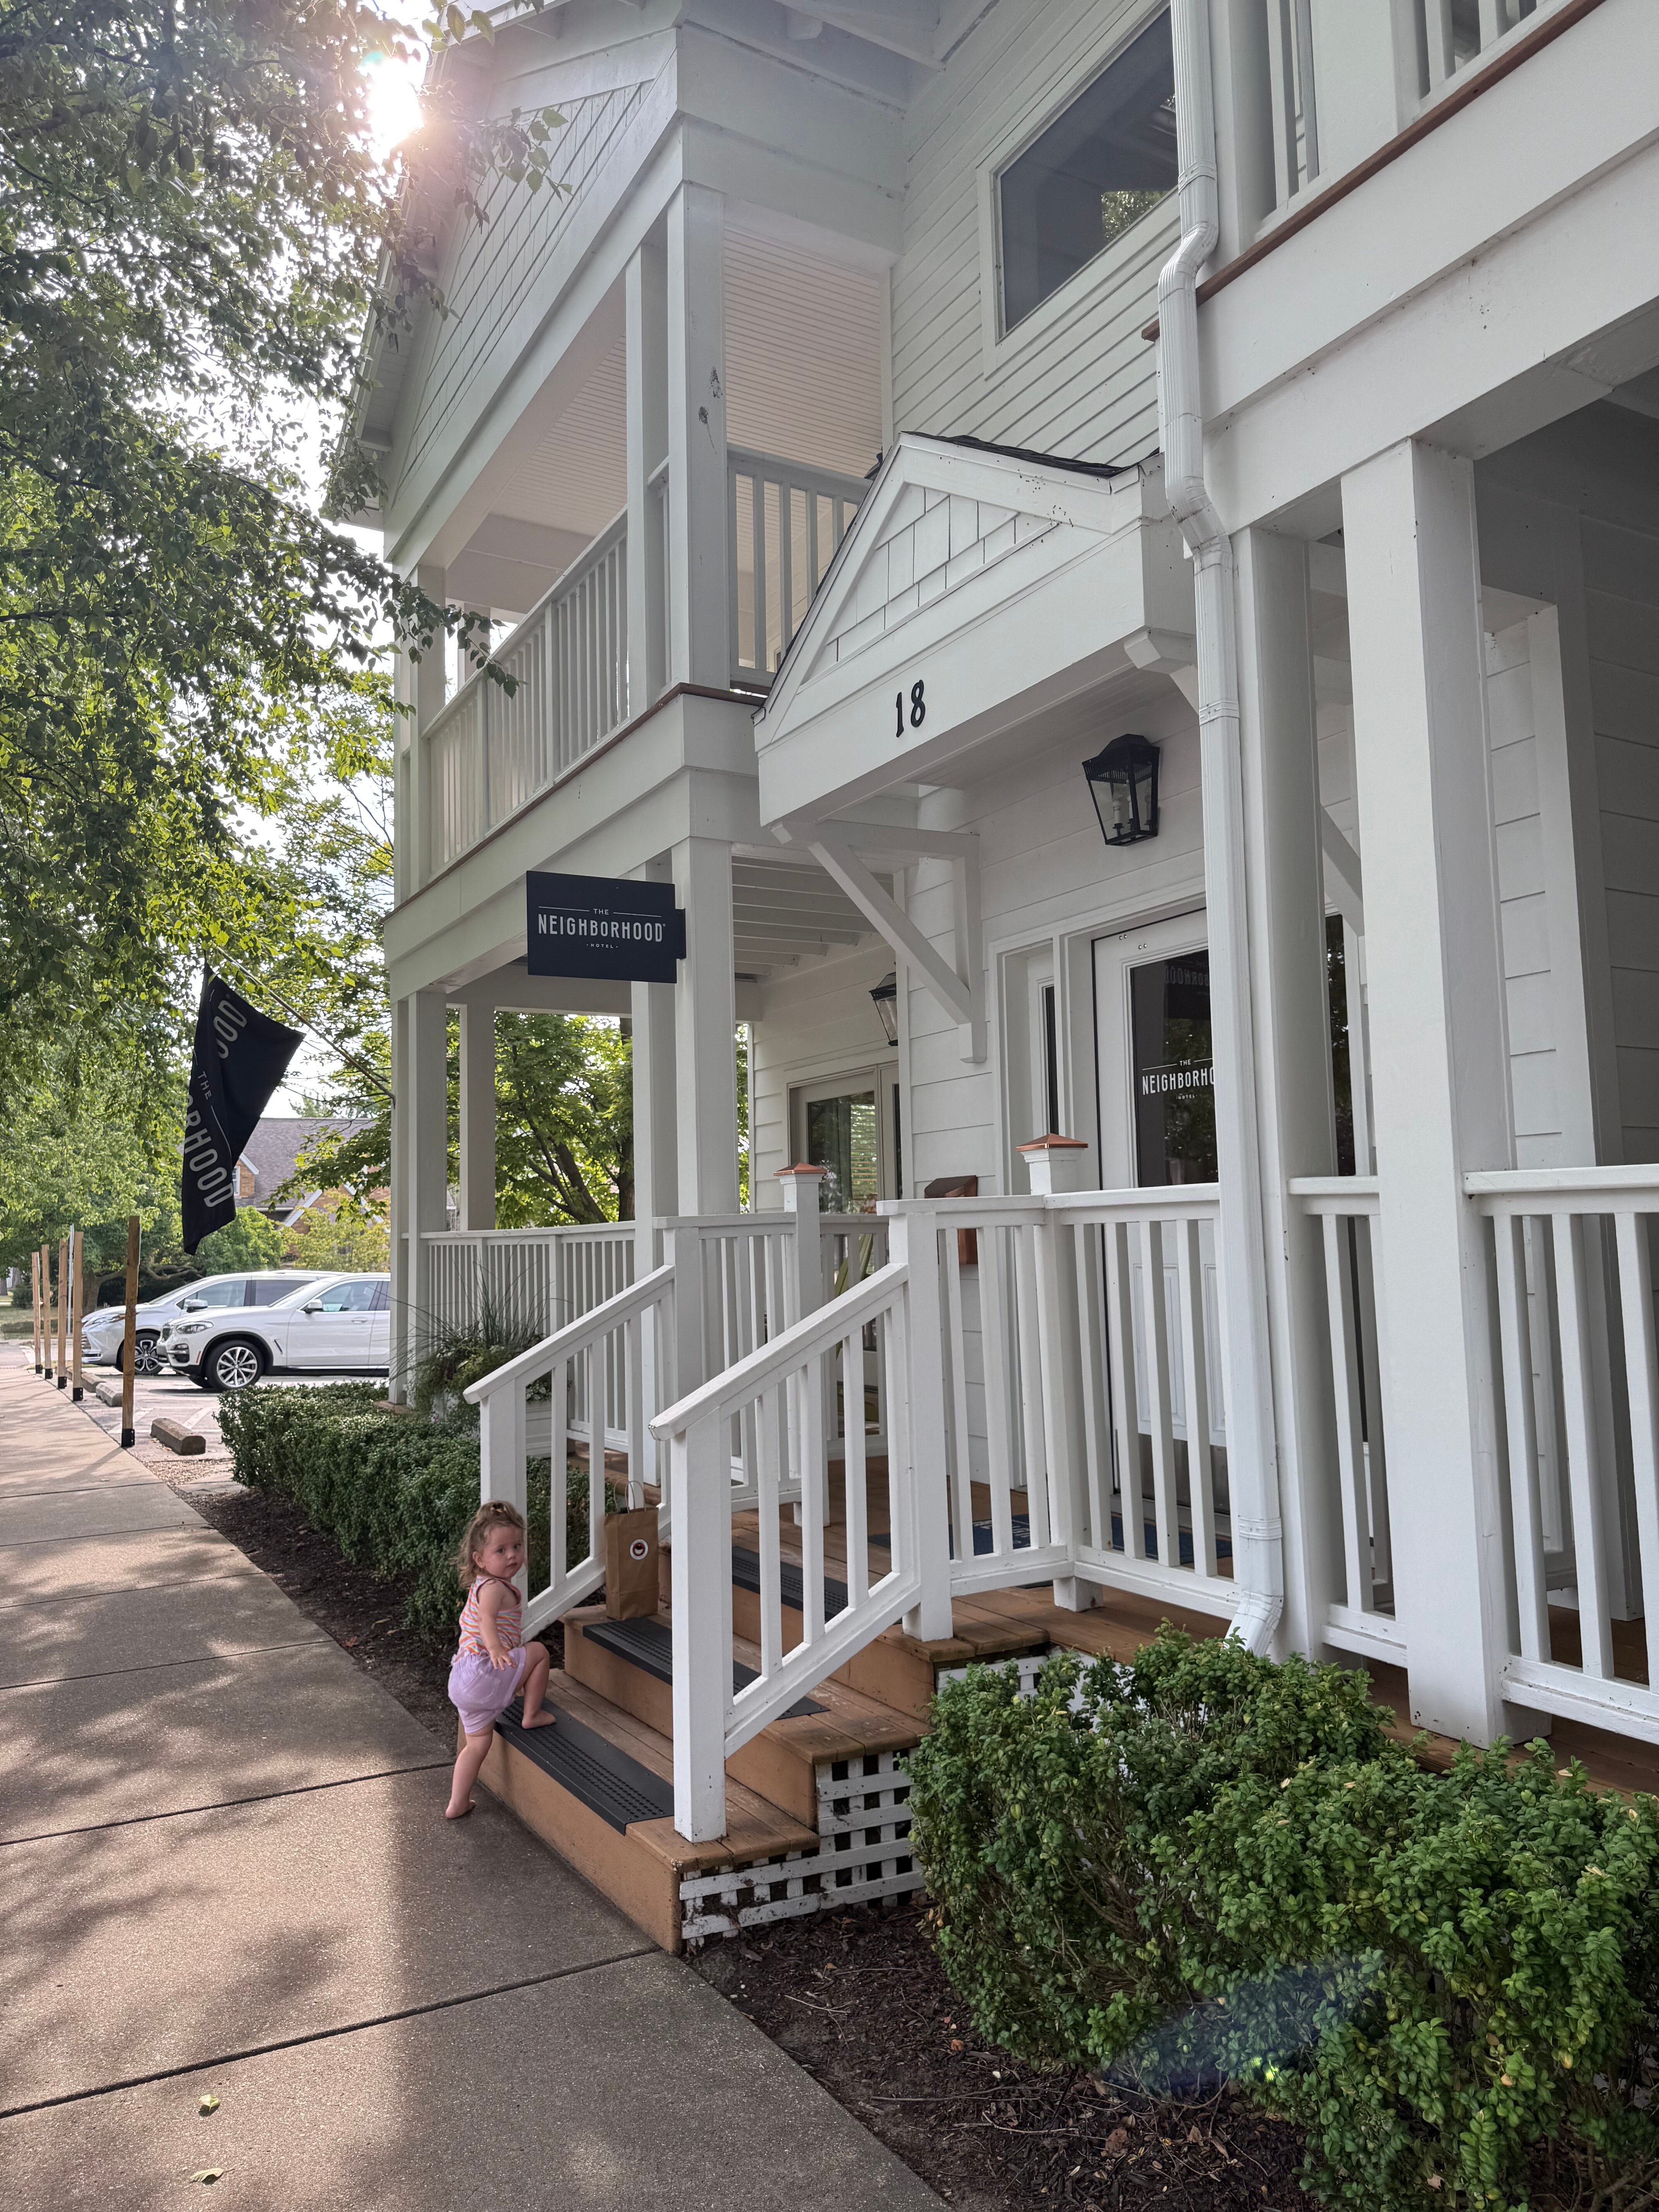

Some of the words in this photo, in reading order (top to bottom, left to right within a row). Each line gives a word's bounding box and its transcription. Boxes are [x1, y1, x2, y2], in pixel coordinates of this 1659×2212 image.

[896, 679, 926, 738] 18
[538, 914, 663, 942] NEIGHBORHOOD
[198, 1071, 212, 1100] THE
